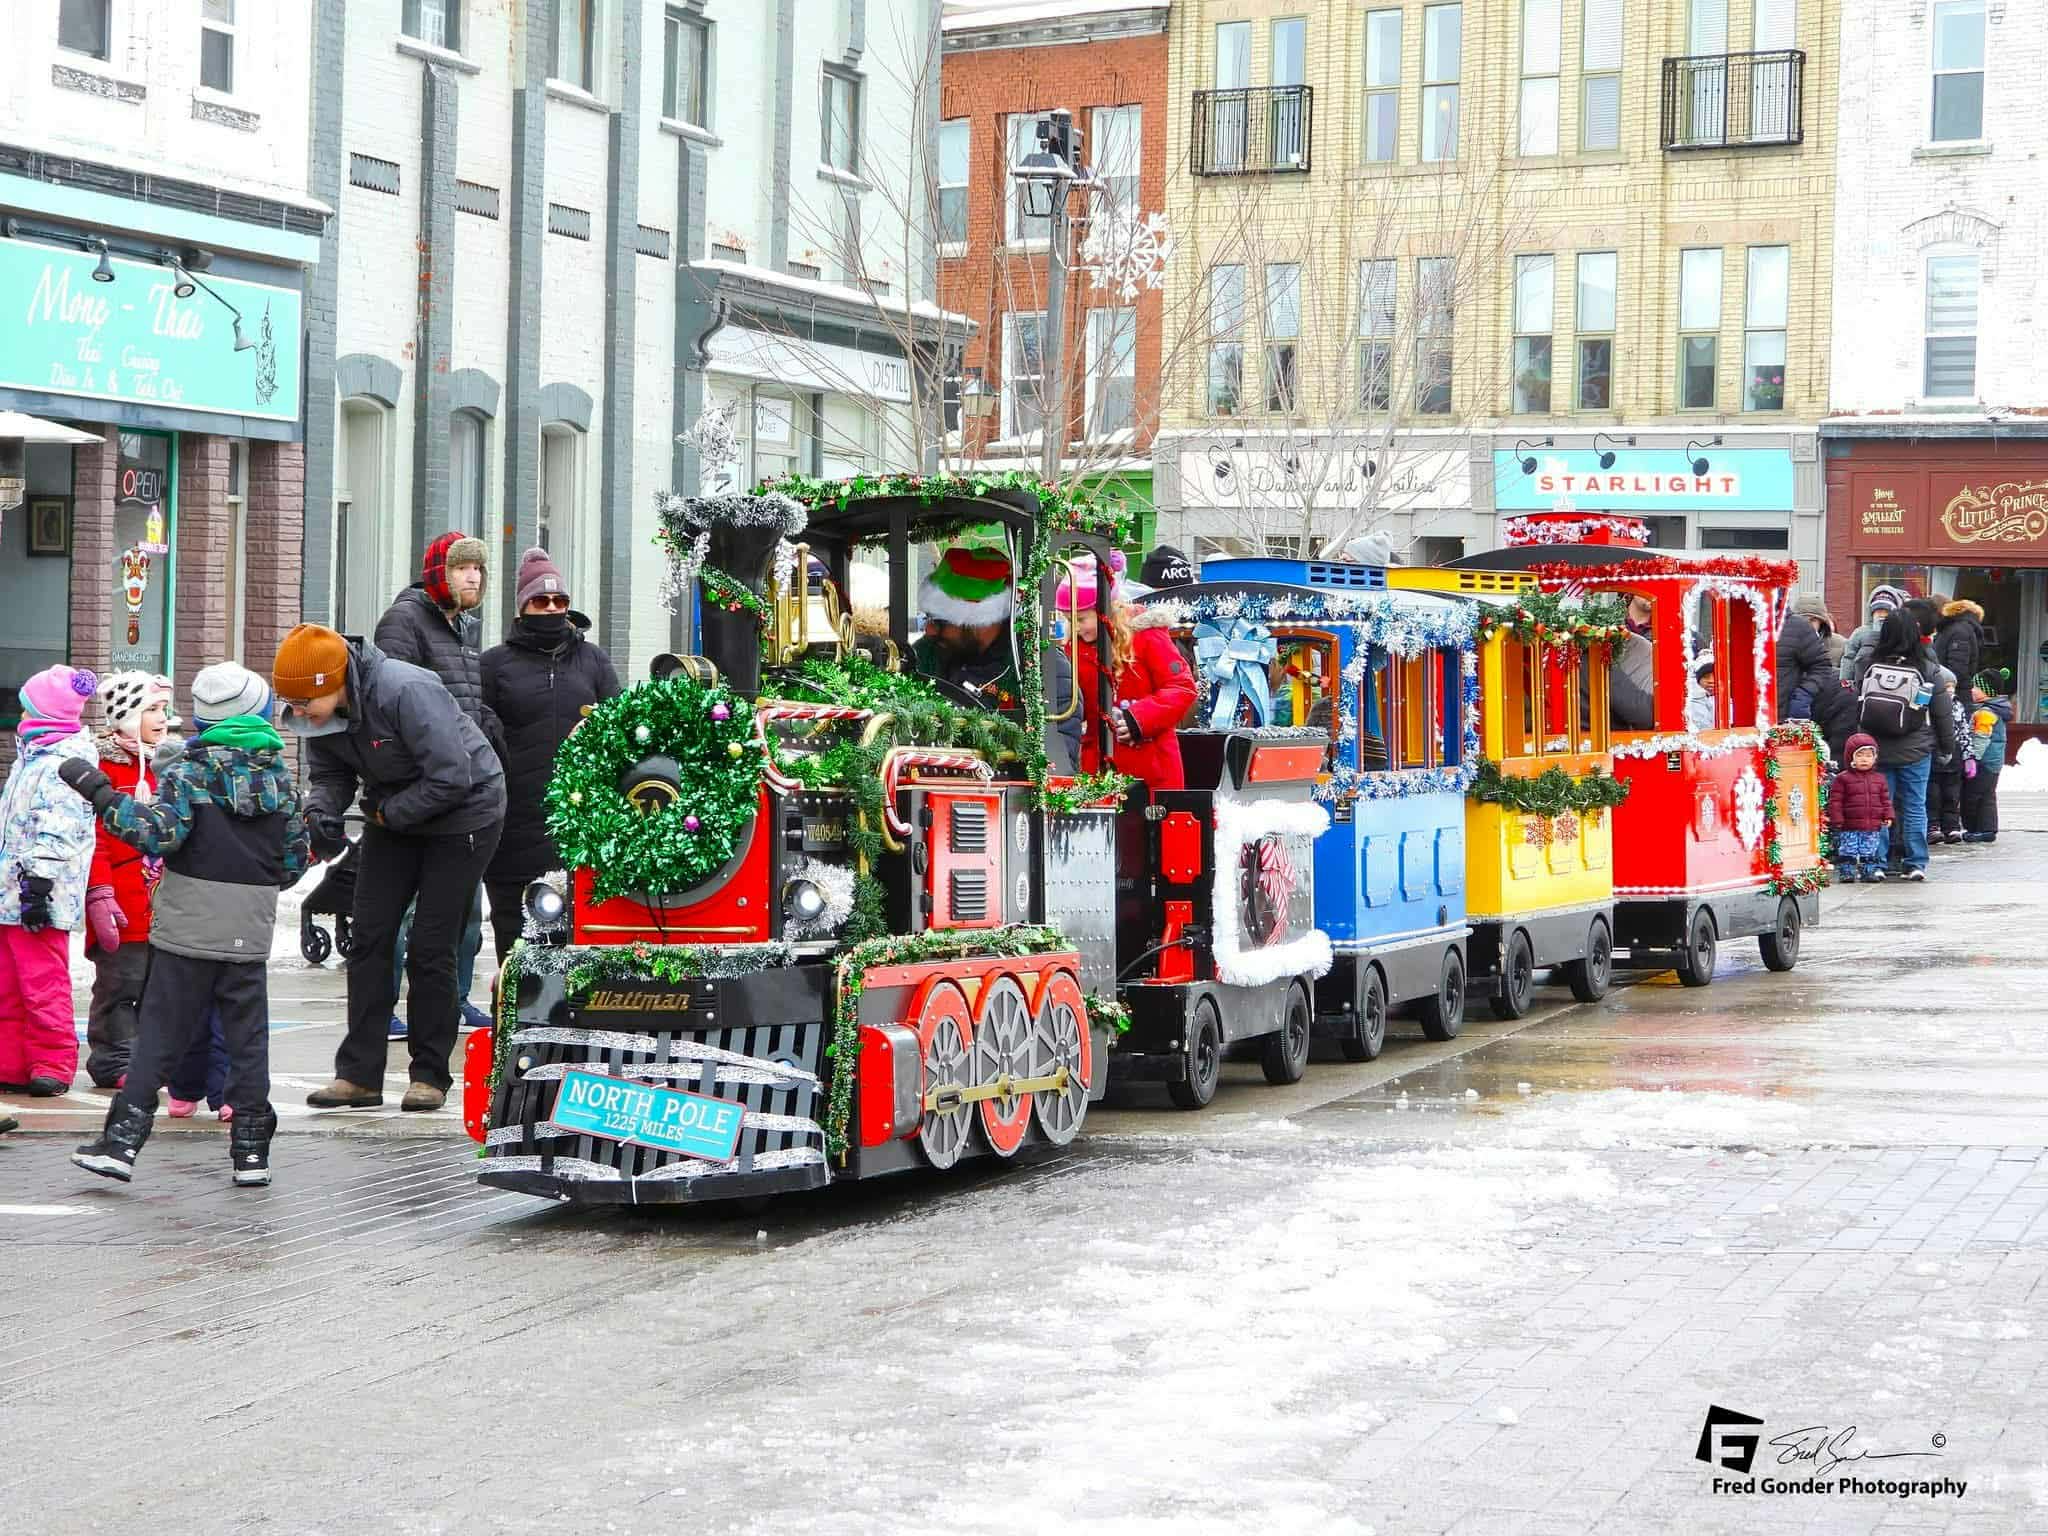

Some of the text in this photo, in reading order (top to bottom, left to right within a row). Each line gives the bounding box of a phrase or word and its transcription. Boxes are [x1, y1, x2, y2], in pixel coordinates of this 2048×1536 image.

[147, 284, 206, 340] Thai
[123, 469, 161, 498] OPEN
[1540, 475, 1735, 493] STARLIGHT
[1958, 506, 1998, 529] LITTLE
[584, 991, 690, 1011] Wattman
[567, 1079, 733, 1135] NORTH POLE
[603, 1112, 686, 1142] 1225 MILES
